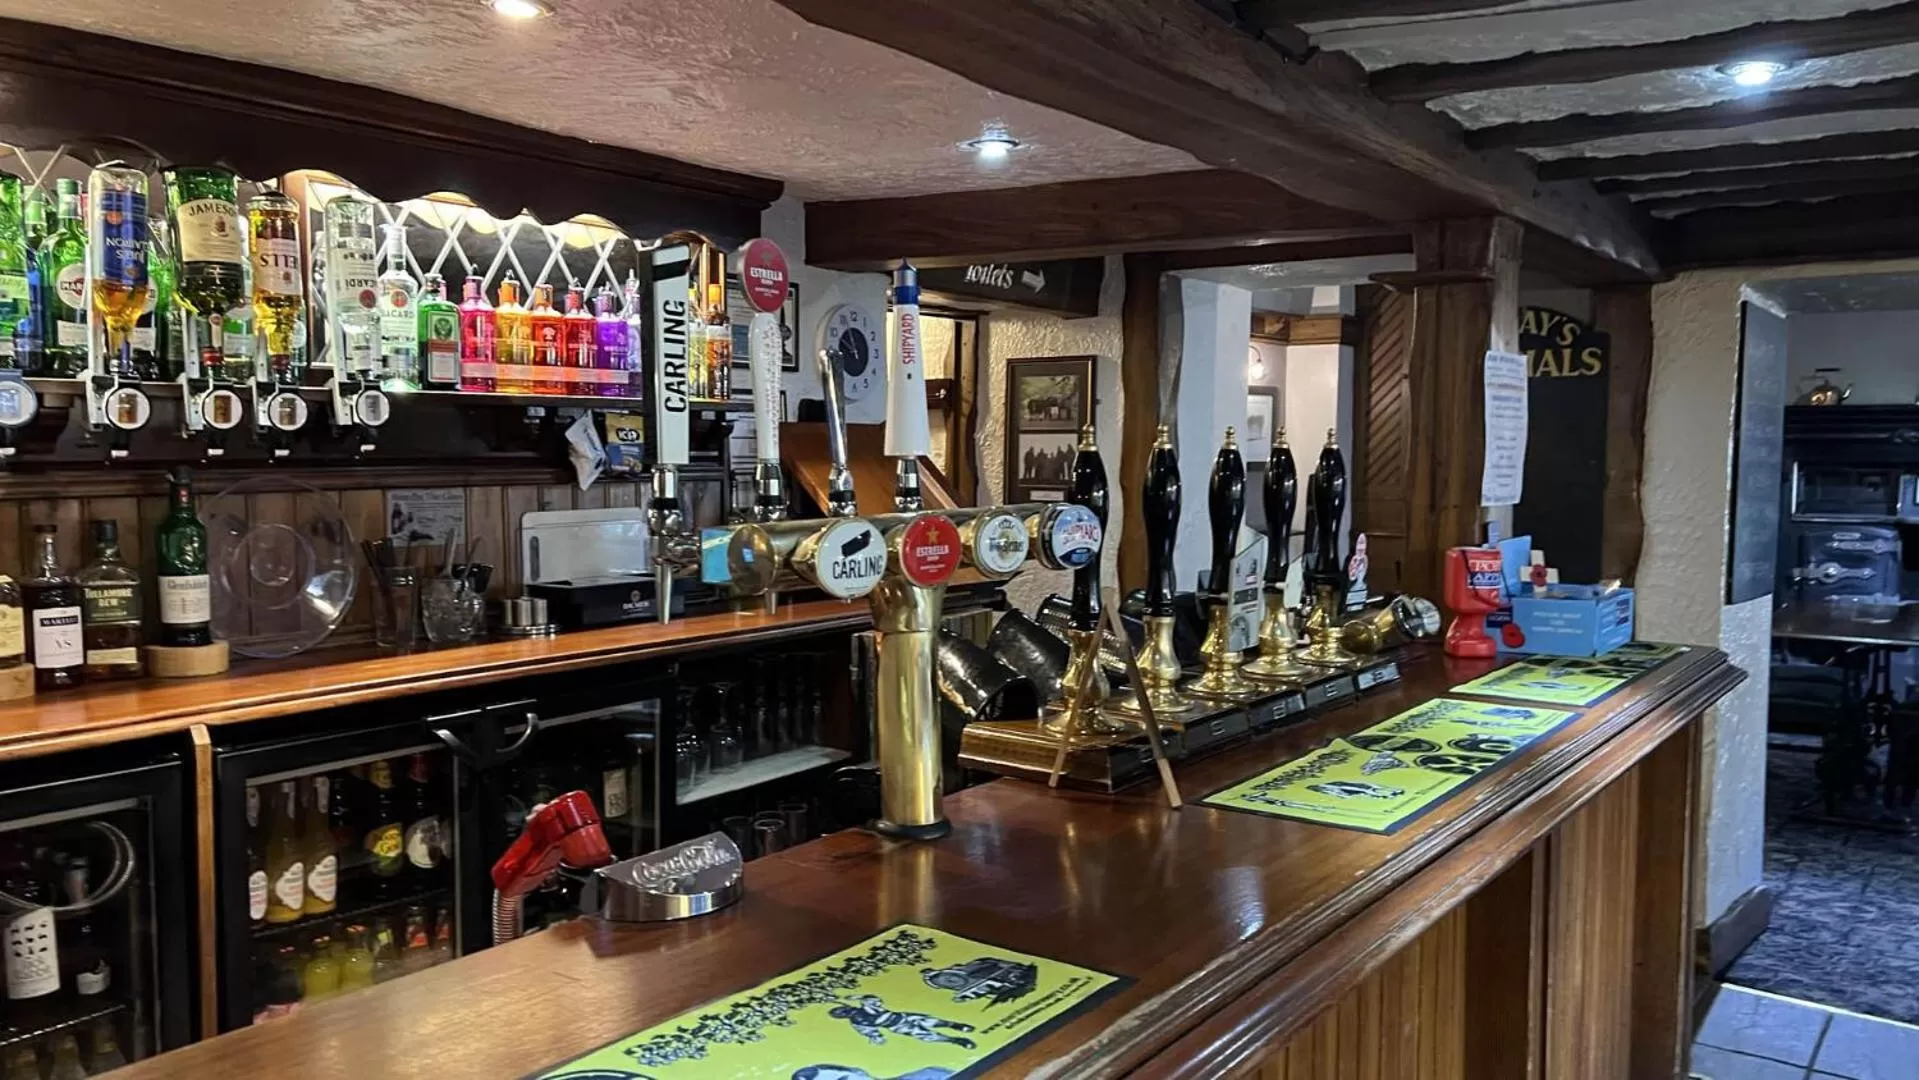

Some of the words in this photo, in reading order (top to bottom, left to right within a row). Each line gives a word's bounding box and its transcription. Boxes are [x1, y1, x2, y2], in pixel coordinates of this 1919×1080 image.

[663, 299, 687, 413] CARLING
[901, 313, 916, 365] SHIPYARD
[832, 555, 884, 580] CARLING
